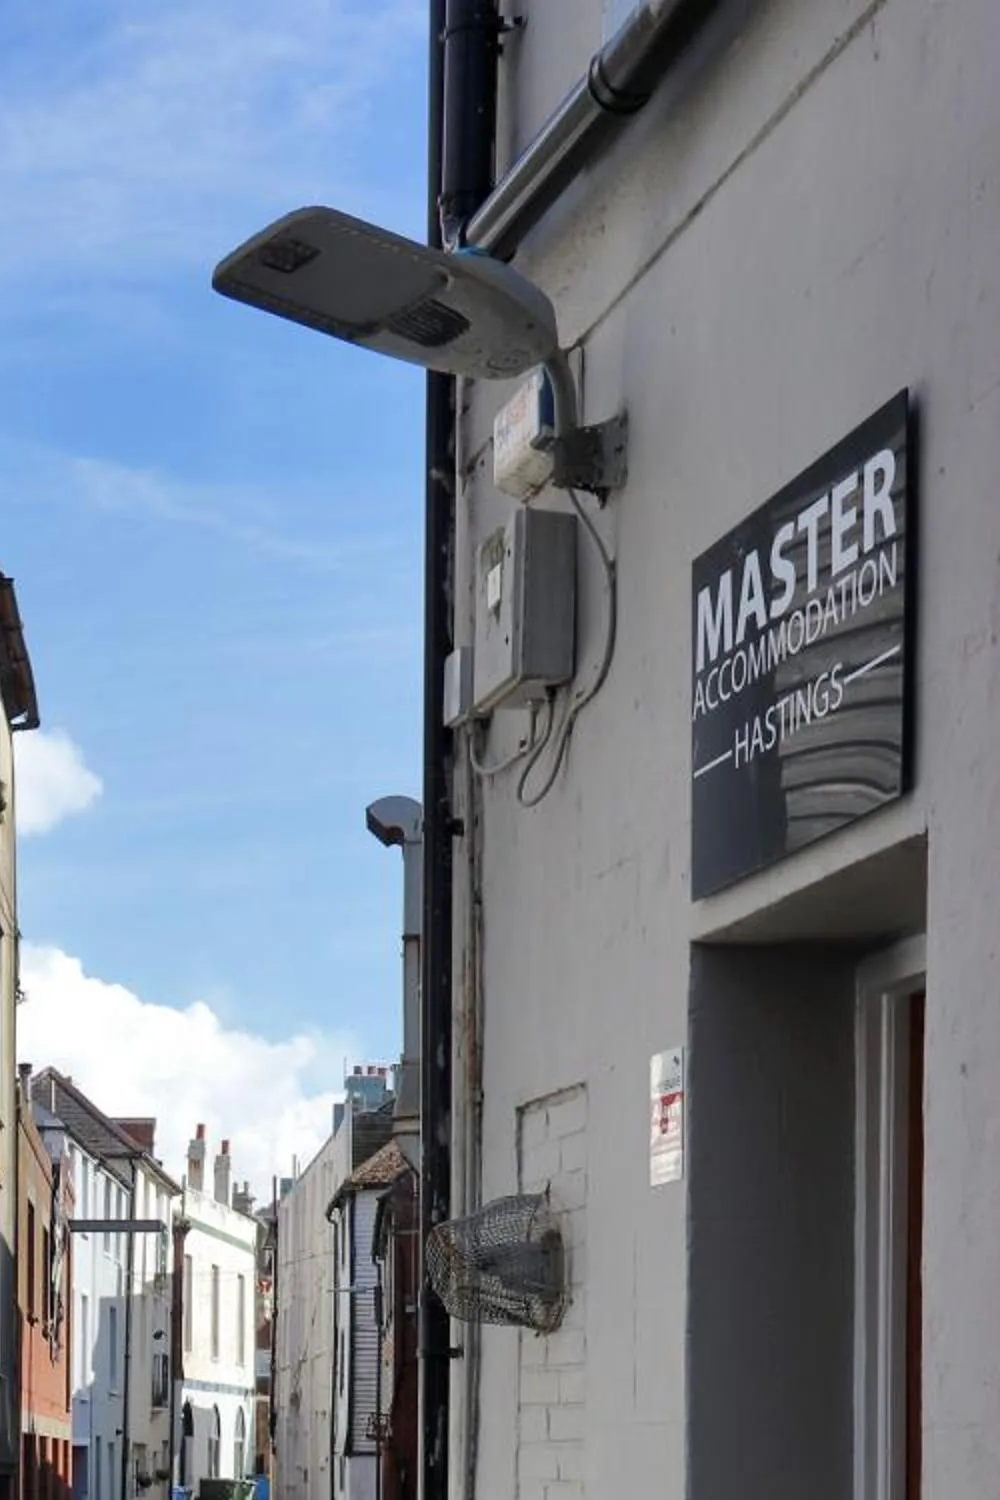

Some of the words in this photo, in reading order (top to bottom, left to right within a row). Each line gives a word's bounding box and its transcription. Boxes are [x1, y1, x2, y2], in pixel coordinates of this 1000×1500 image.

[693, 542, 897, 721] ACCOMMODATION
[696, 448, 897, 673] MASTER
[735, 662, 844, 769] HASTINGS
